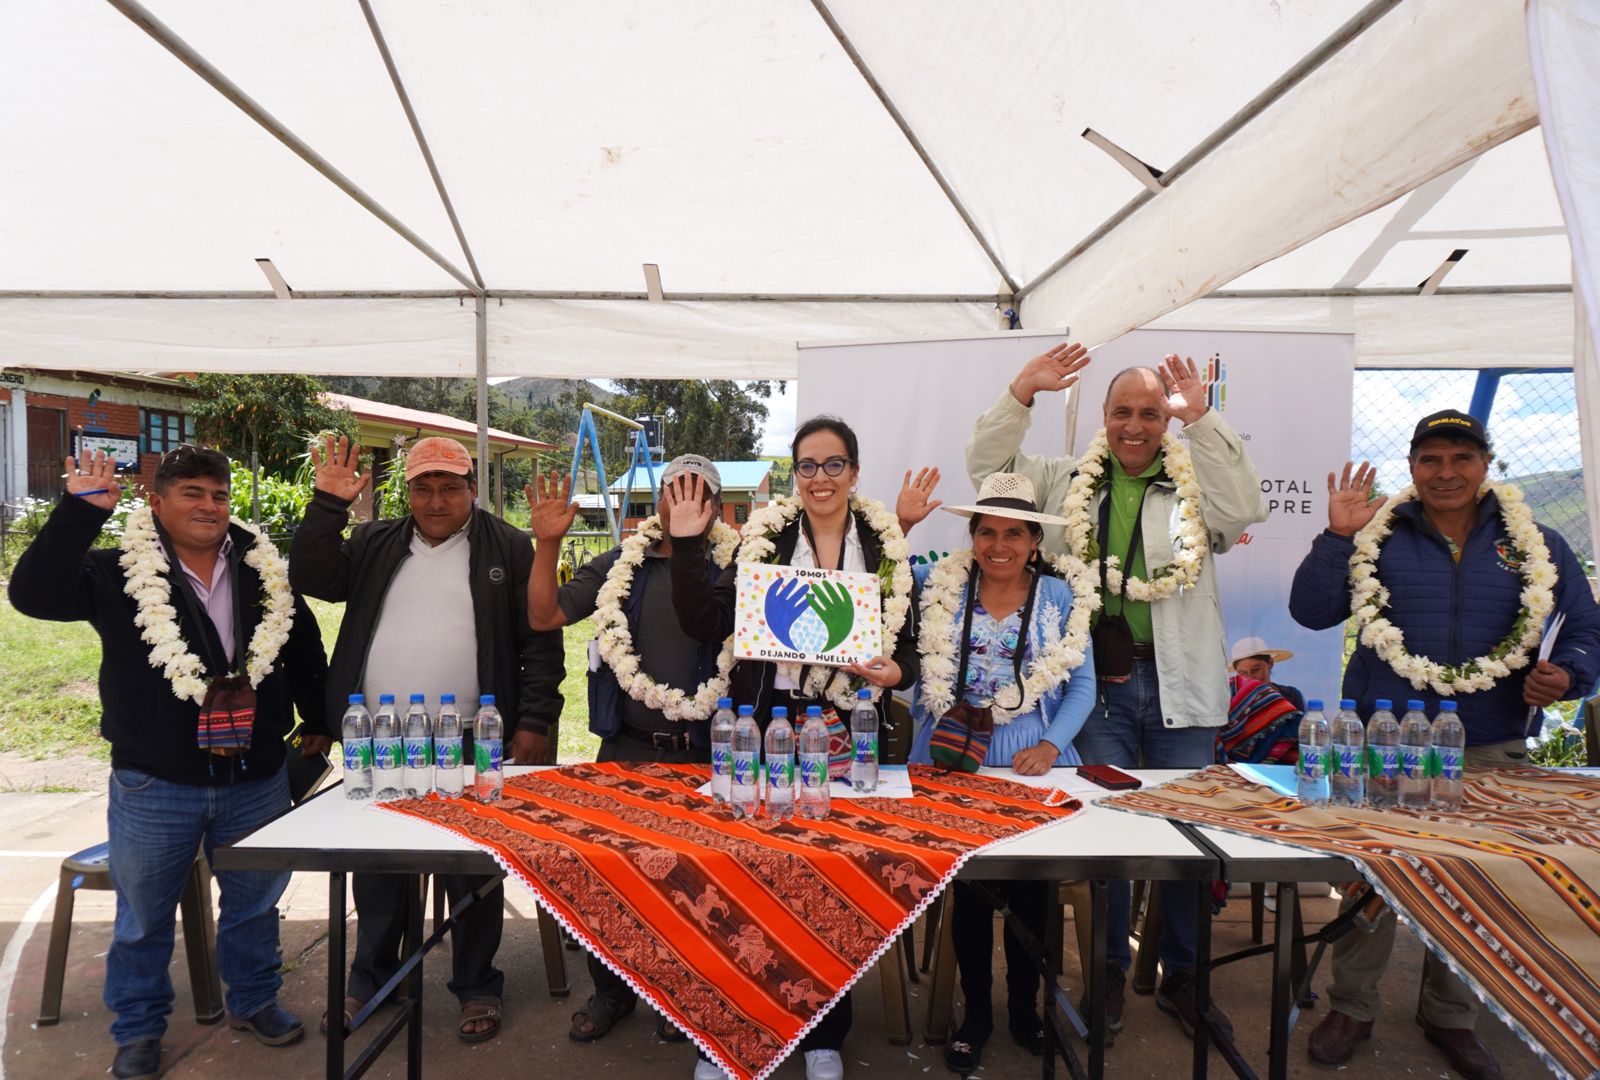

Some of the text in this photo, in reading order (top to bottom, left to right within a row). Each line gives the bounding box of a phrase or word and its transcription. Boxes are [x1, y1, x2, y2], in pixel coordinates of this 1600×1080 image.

[1261, 479, 1312, 493] OTAL
[795, 569, 827, 579] SOMOS
[760, 649, 858, 664] DEJANDO HUELLAS
